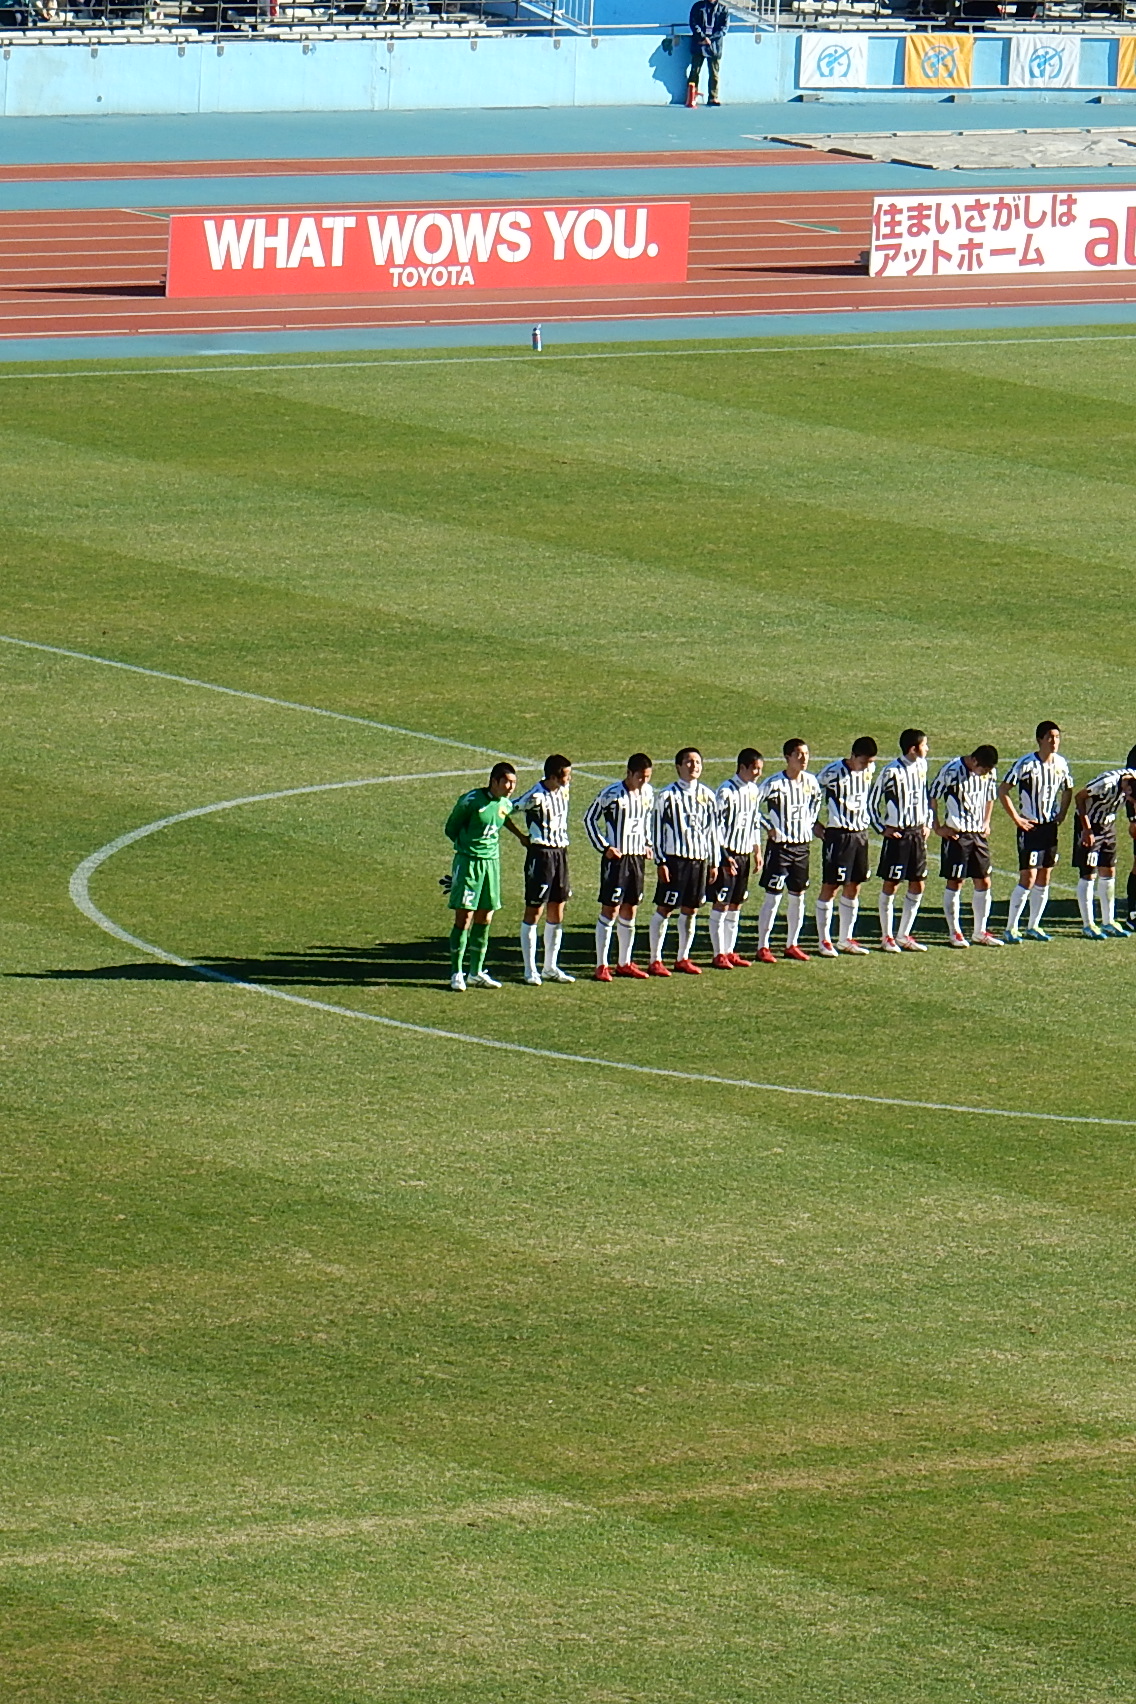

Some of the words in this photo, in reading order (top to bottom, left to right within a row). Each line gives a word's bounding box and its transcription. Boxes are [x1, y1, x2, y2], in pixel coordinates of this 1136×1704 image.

[873, 193, 1078, 242] 住まいさがしは
[203, 216, 357, 271] WHAT
[366, 210, 532, 266] WOWS
[543, 208, 659, 261] YOU.
[874, 233, 1046, 277] アットホーム
[389, 265, 475, 288] TOYOTA
[631, 820, 639, 834] 2
[1029, 851, 1038, 866] 8
[1087, 852, 1099, 867] 10
[836, 867, 847, 881] 5
[888, 865, 903, 879] 15
[951, 864, 964, 878] 11
[768, 874, 785, 890] 20
[462, 889, 476, 906] 12
[539, 884, 549, 898] 7
[611, 888, 622, 902] 2
[664, 891, 679, 905] 13
